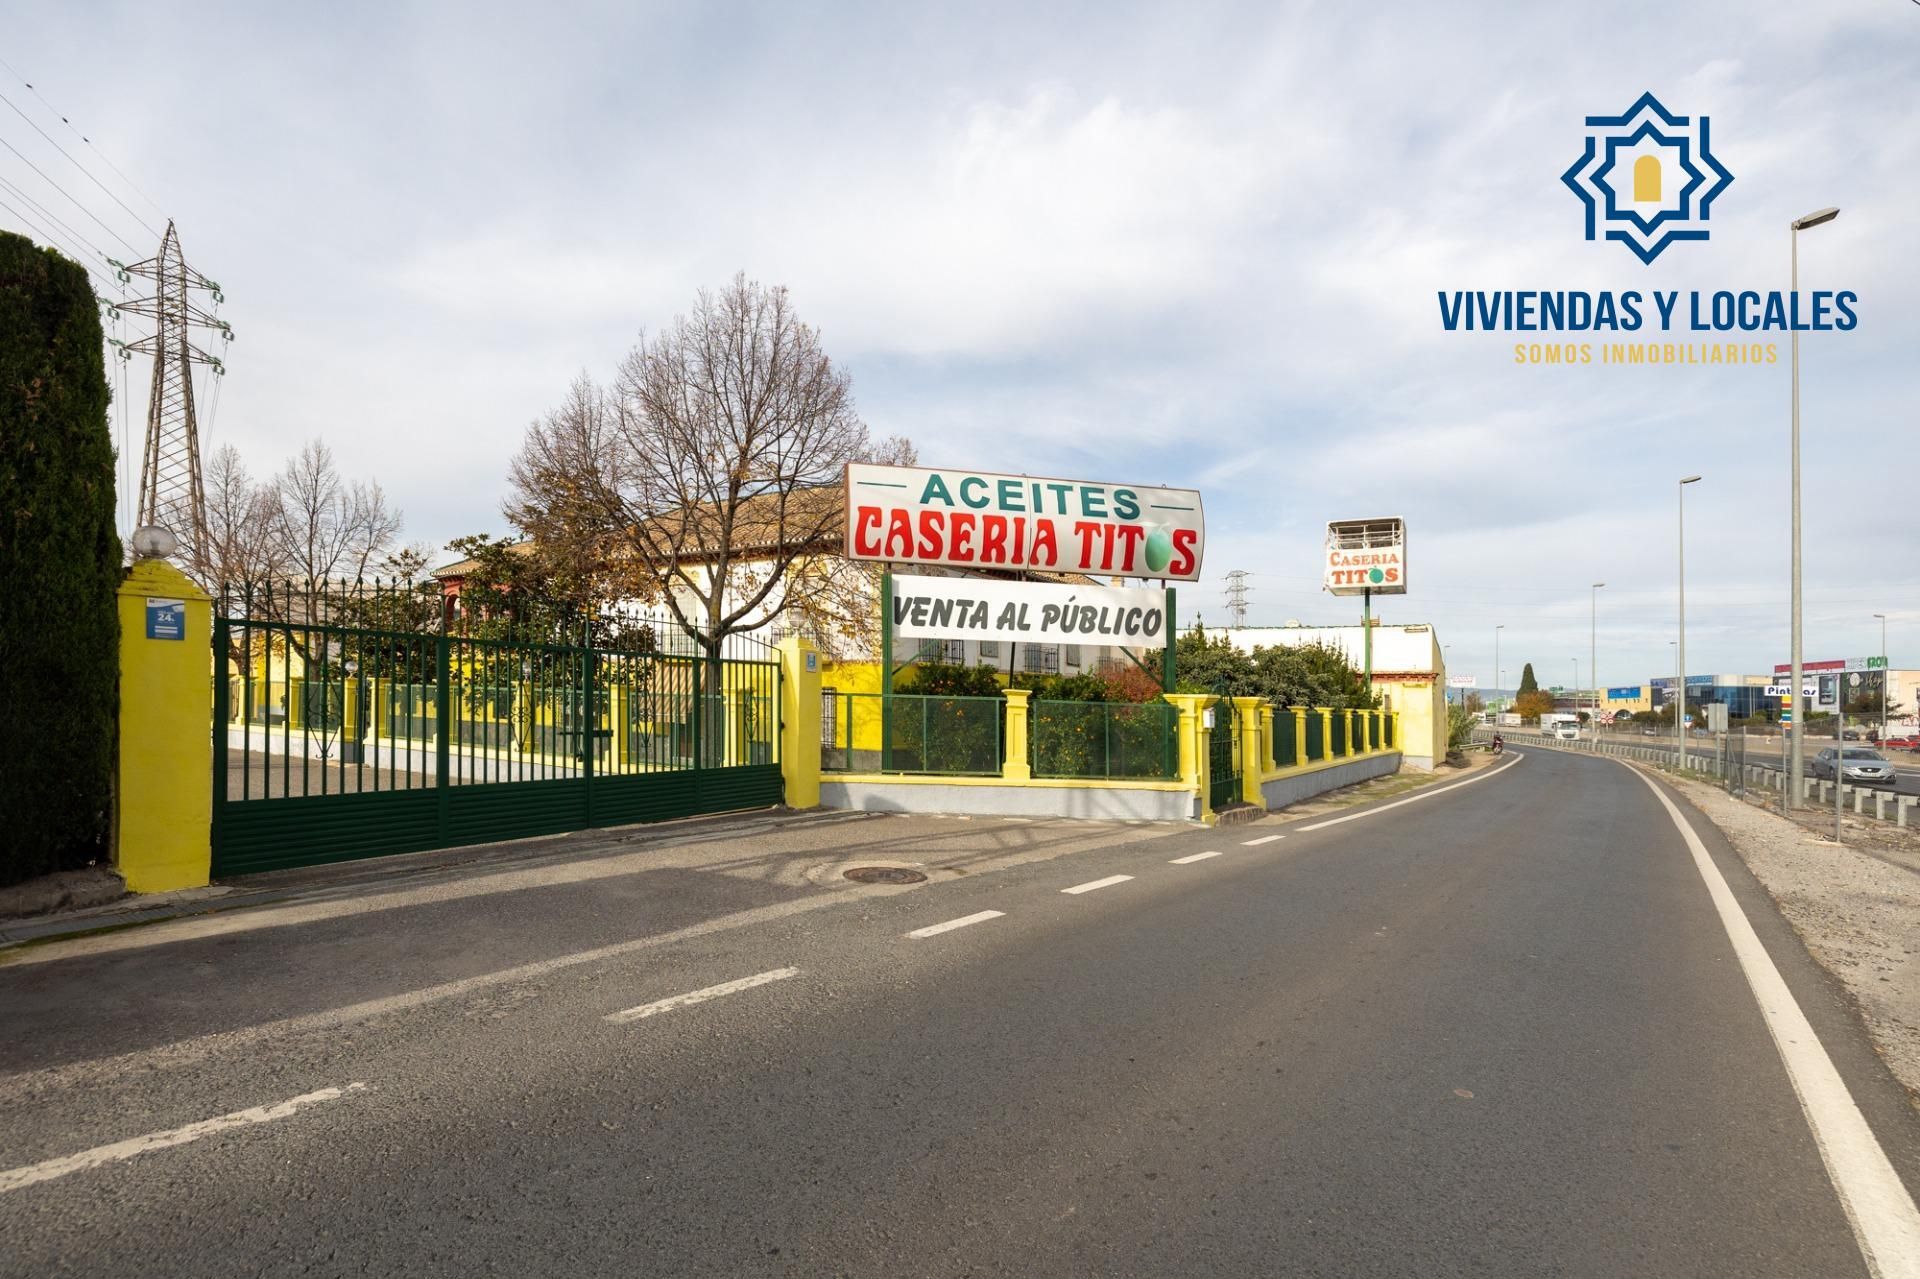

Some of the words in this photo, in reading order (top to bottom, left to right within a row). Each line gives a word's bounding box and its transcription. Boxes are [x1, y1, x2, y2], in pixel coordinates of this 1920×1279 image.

[920, 473, 1141, 520] ACEITES
[855, 505, 1057, 567] CASERIA
[1074, 520, 1197, 576] TITOS
[1330, 552, 1399, 567] CASERIA
[1332, 567, 1399, 584] TITOS
[893, 596, 989, 630] VENTA
[996, 601, 1031, 631] AL
[1041, 595, 1162, 637] PÚBLICO
[1767, 686, 1817, 696] Pintas
